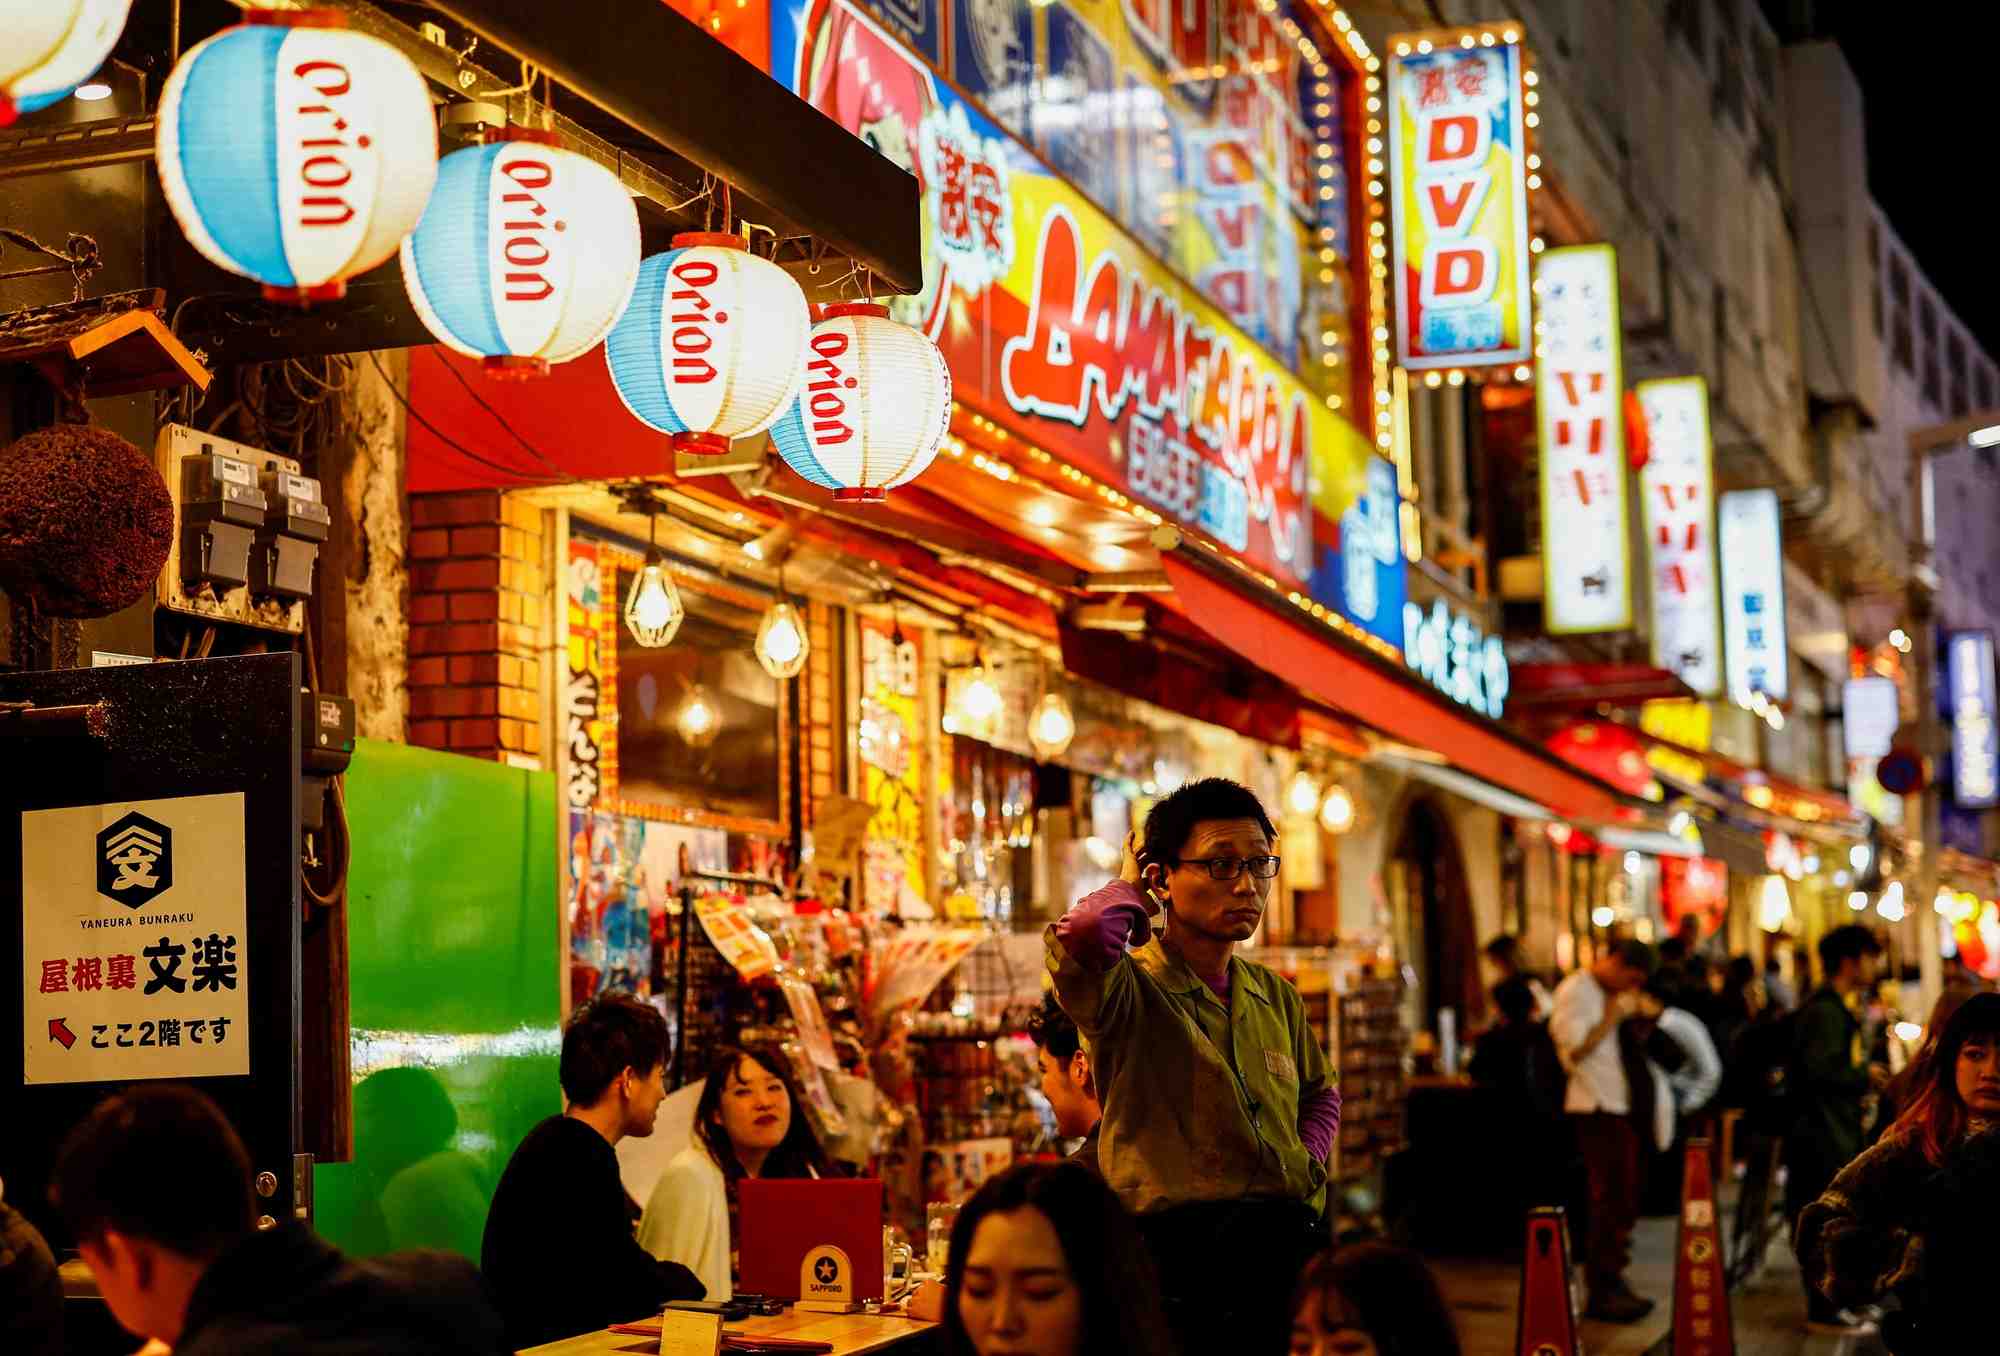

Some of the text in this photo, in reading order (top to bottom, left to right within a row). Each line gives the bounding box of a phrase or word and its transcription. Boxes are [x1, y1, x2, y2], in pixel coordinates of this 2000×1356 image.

[1425, 113, 1487, 298] DVD
[80, 913, 194, 930] YANEURA BUNRAKU
[91, 1016, 232, 1049] ここ2階です
